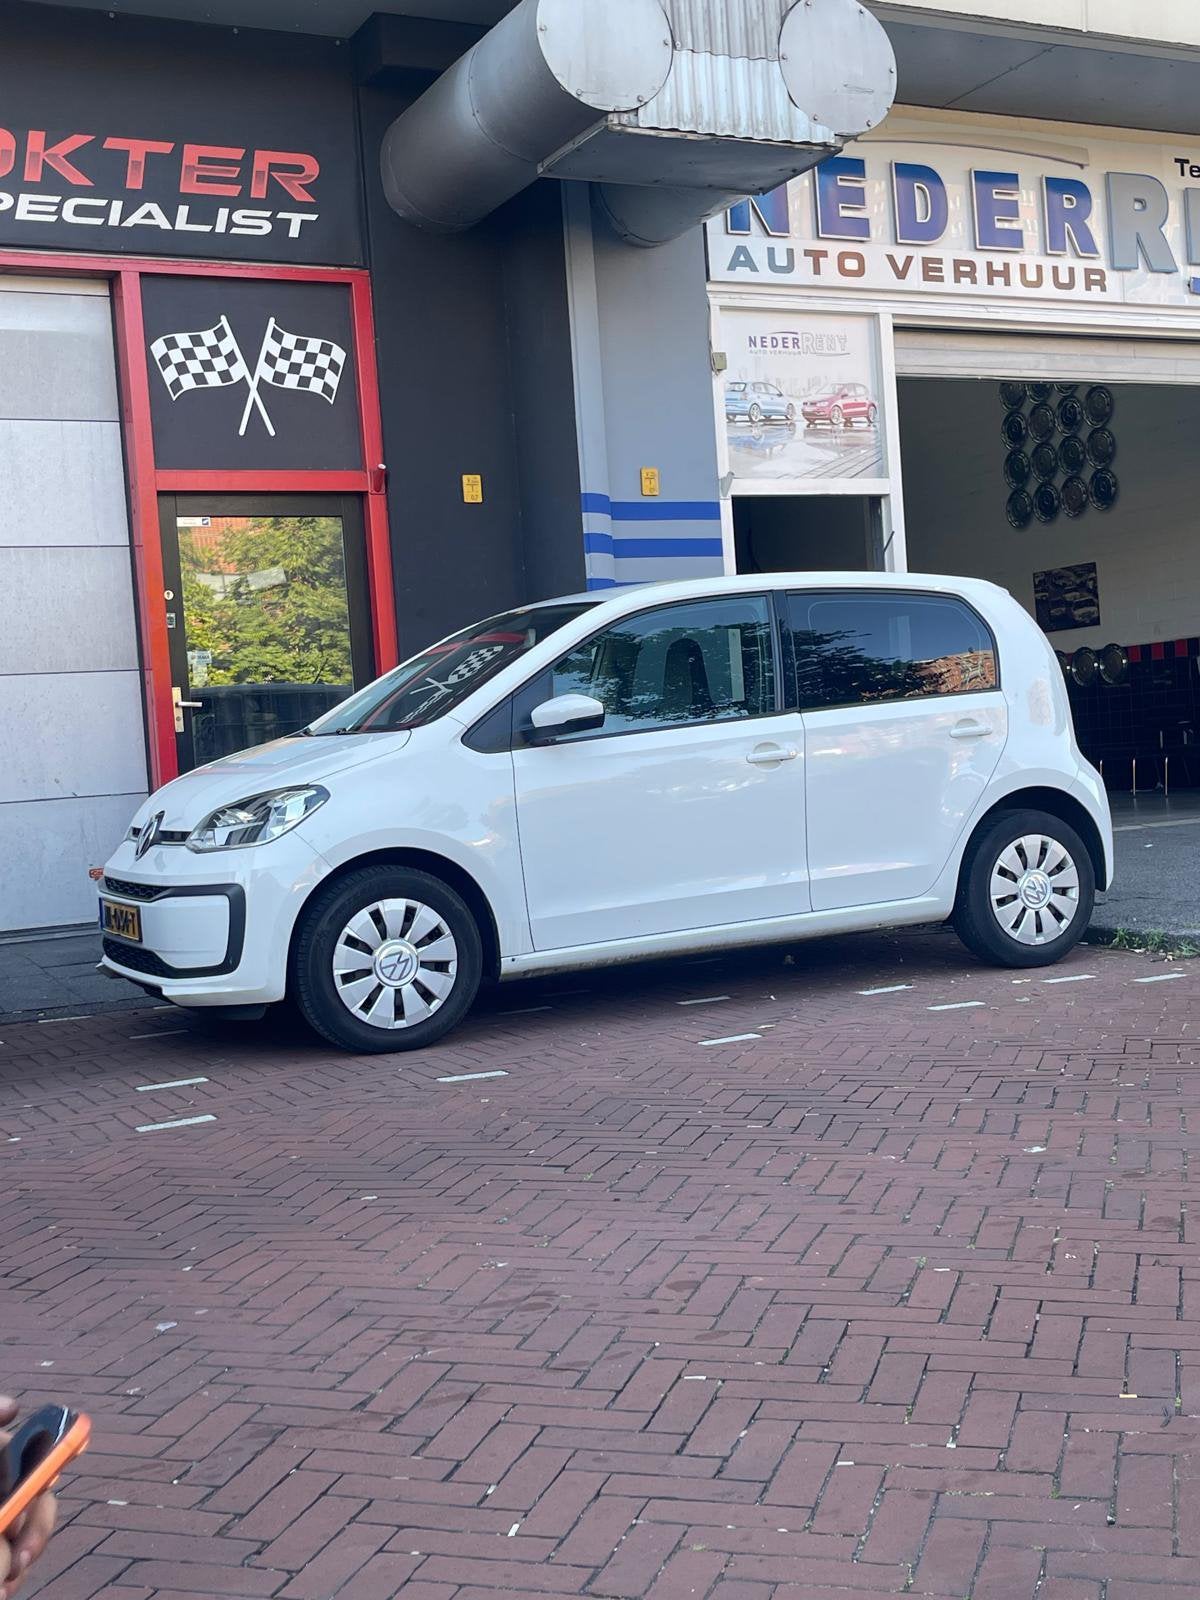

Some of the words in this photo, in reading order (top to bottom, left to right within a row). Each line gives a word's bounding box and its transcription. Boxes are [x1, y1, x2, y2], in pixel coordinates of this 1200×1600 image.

[0, 127, 320, 202] KTER
[726, 245, 866, 278] AUTO
[885, 254, 1107, 293] VERHUUR
